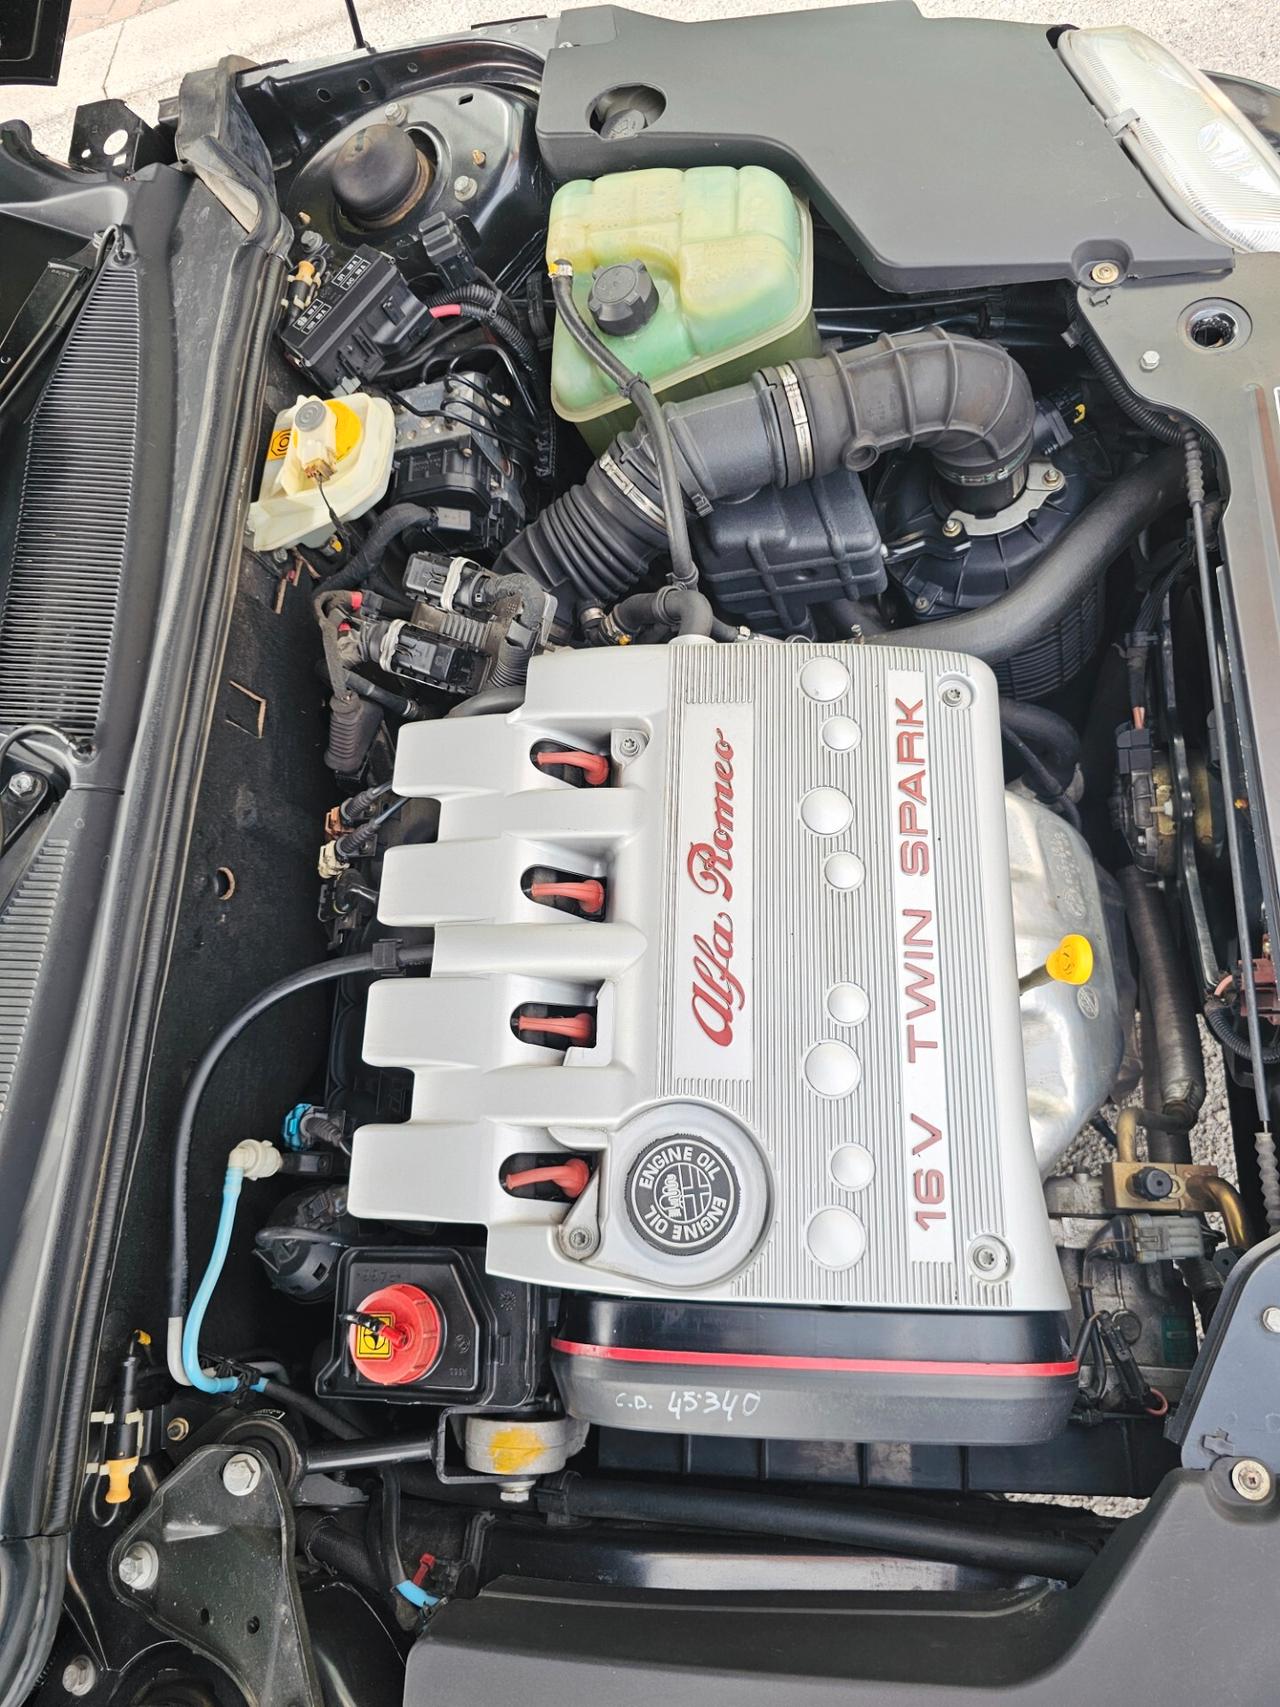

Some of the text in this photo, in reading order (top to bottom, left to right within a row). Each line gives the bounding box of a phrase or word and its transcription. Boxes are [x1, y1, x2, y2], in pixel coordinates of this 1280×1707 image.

[895, 698, 931, 877] SPARK
[687, 727, 745, 1047] Alfa Romeo
[902, 908, 939, 1063] TWIN
[638, 1145, 721, 1190] ENGINE OIL
[643, 1196, 728, 1241] ENGINE OIL
